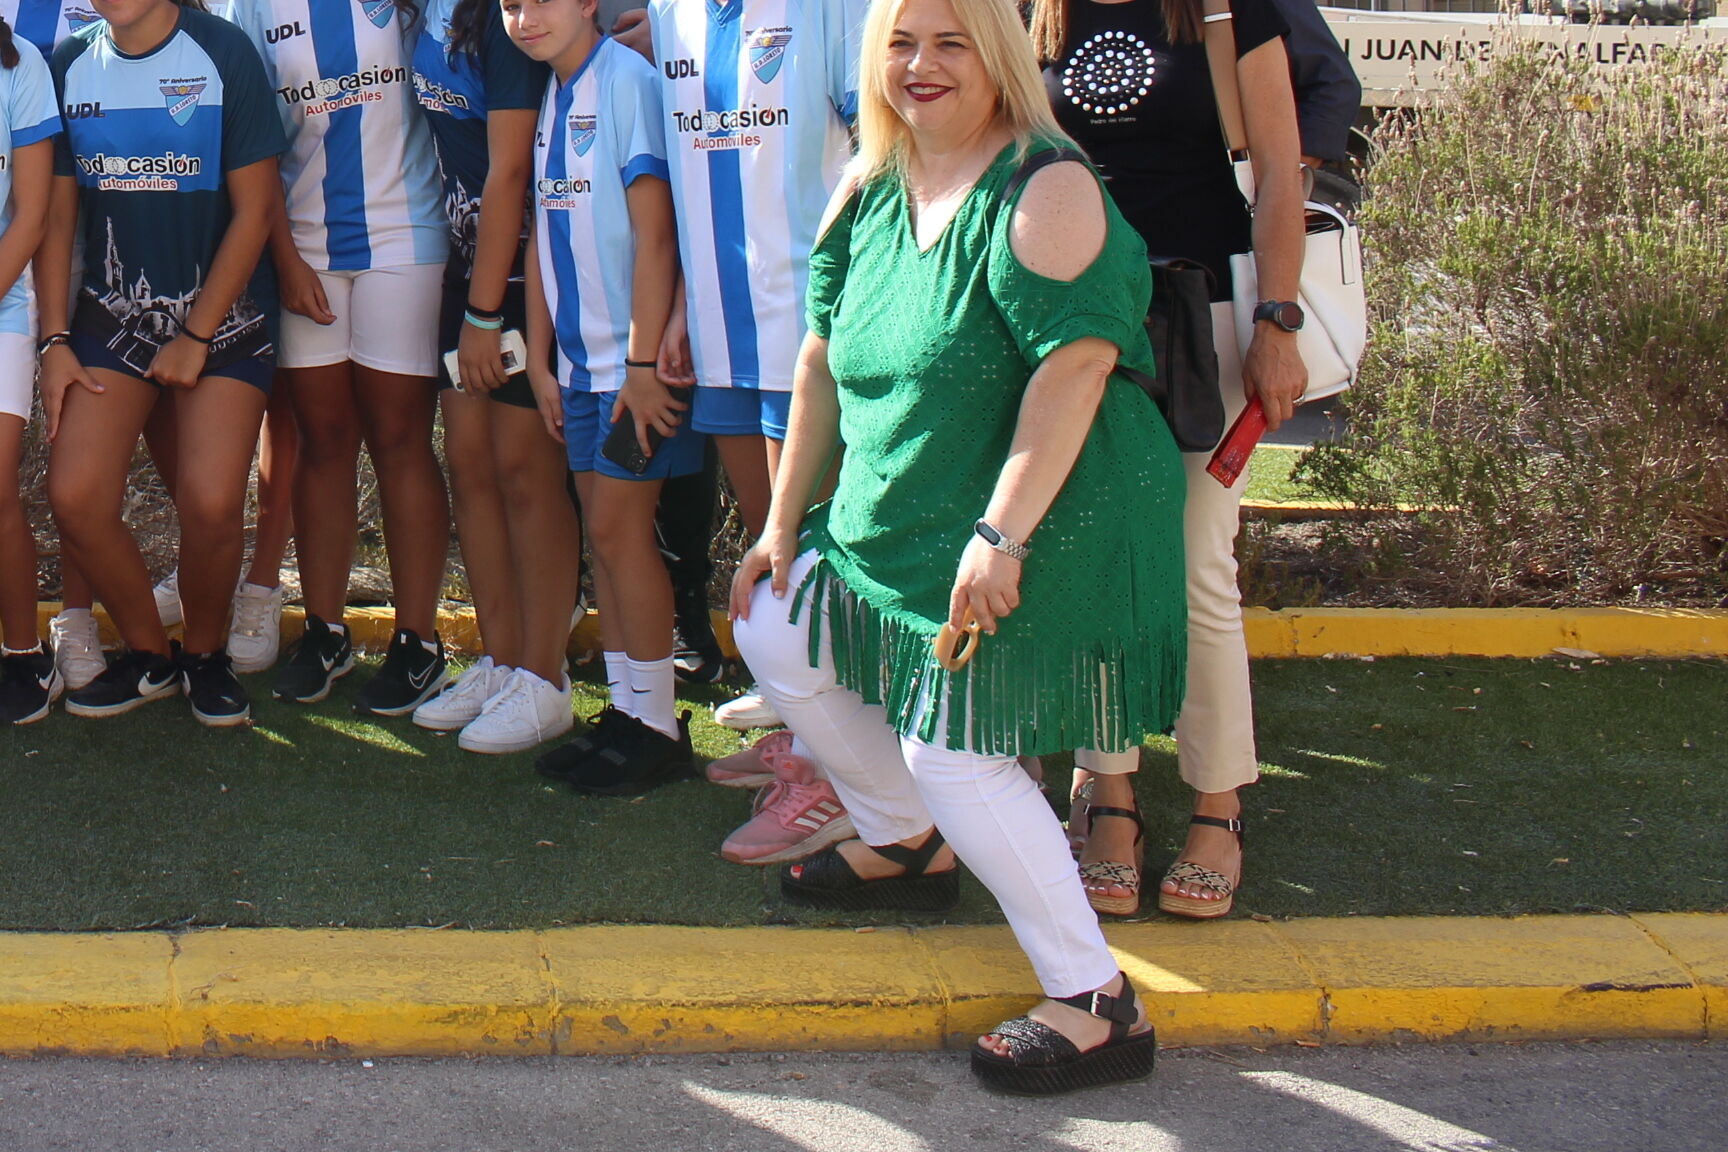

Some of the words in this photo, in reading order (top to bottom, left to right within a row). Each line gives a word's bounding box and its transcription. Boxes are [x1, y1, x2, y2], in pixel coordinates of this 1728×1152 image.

[266, 21, 306, 44] UDL
[1360, 38, 1442, 62] JUAN
[665, 59, 699, 80] UDL
[66, 102, 106, 120] UDL
